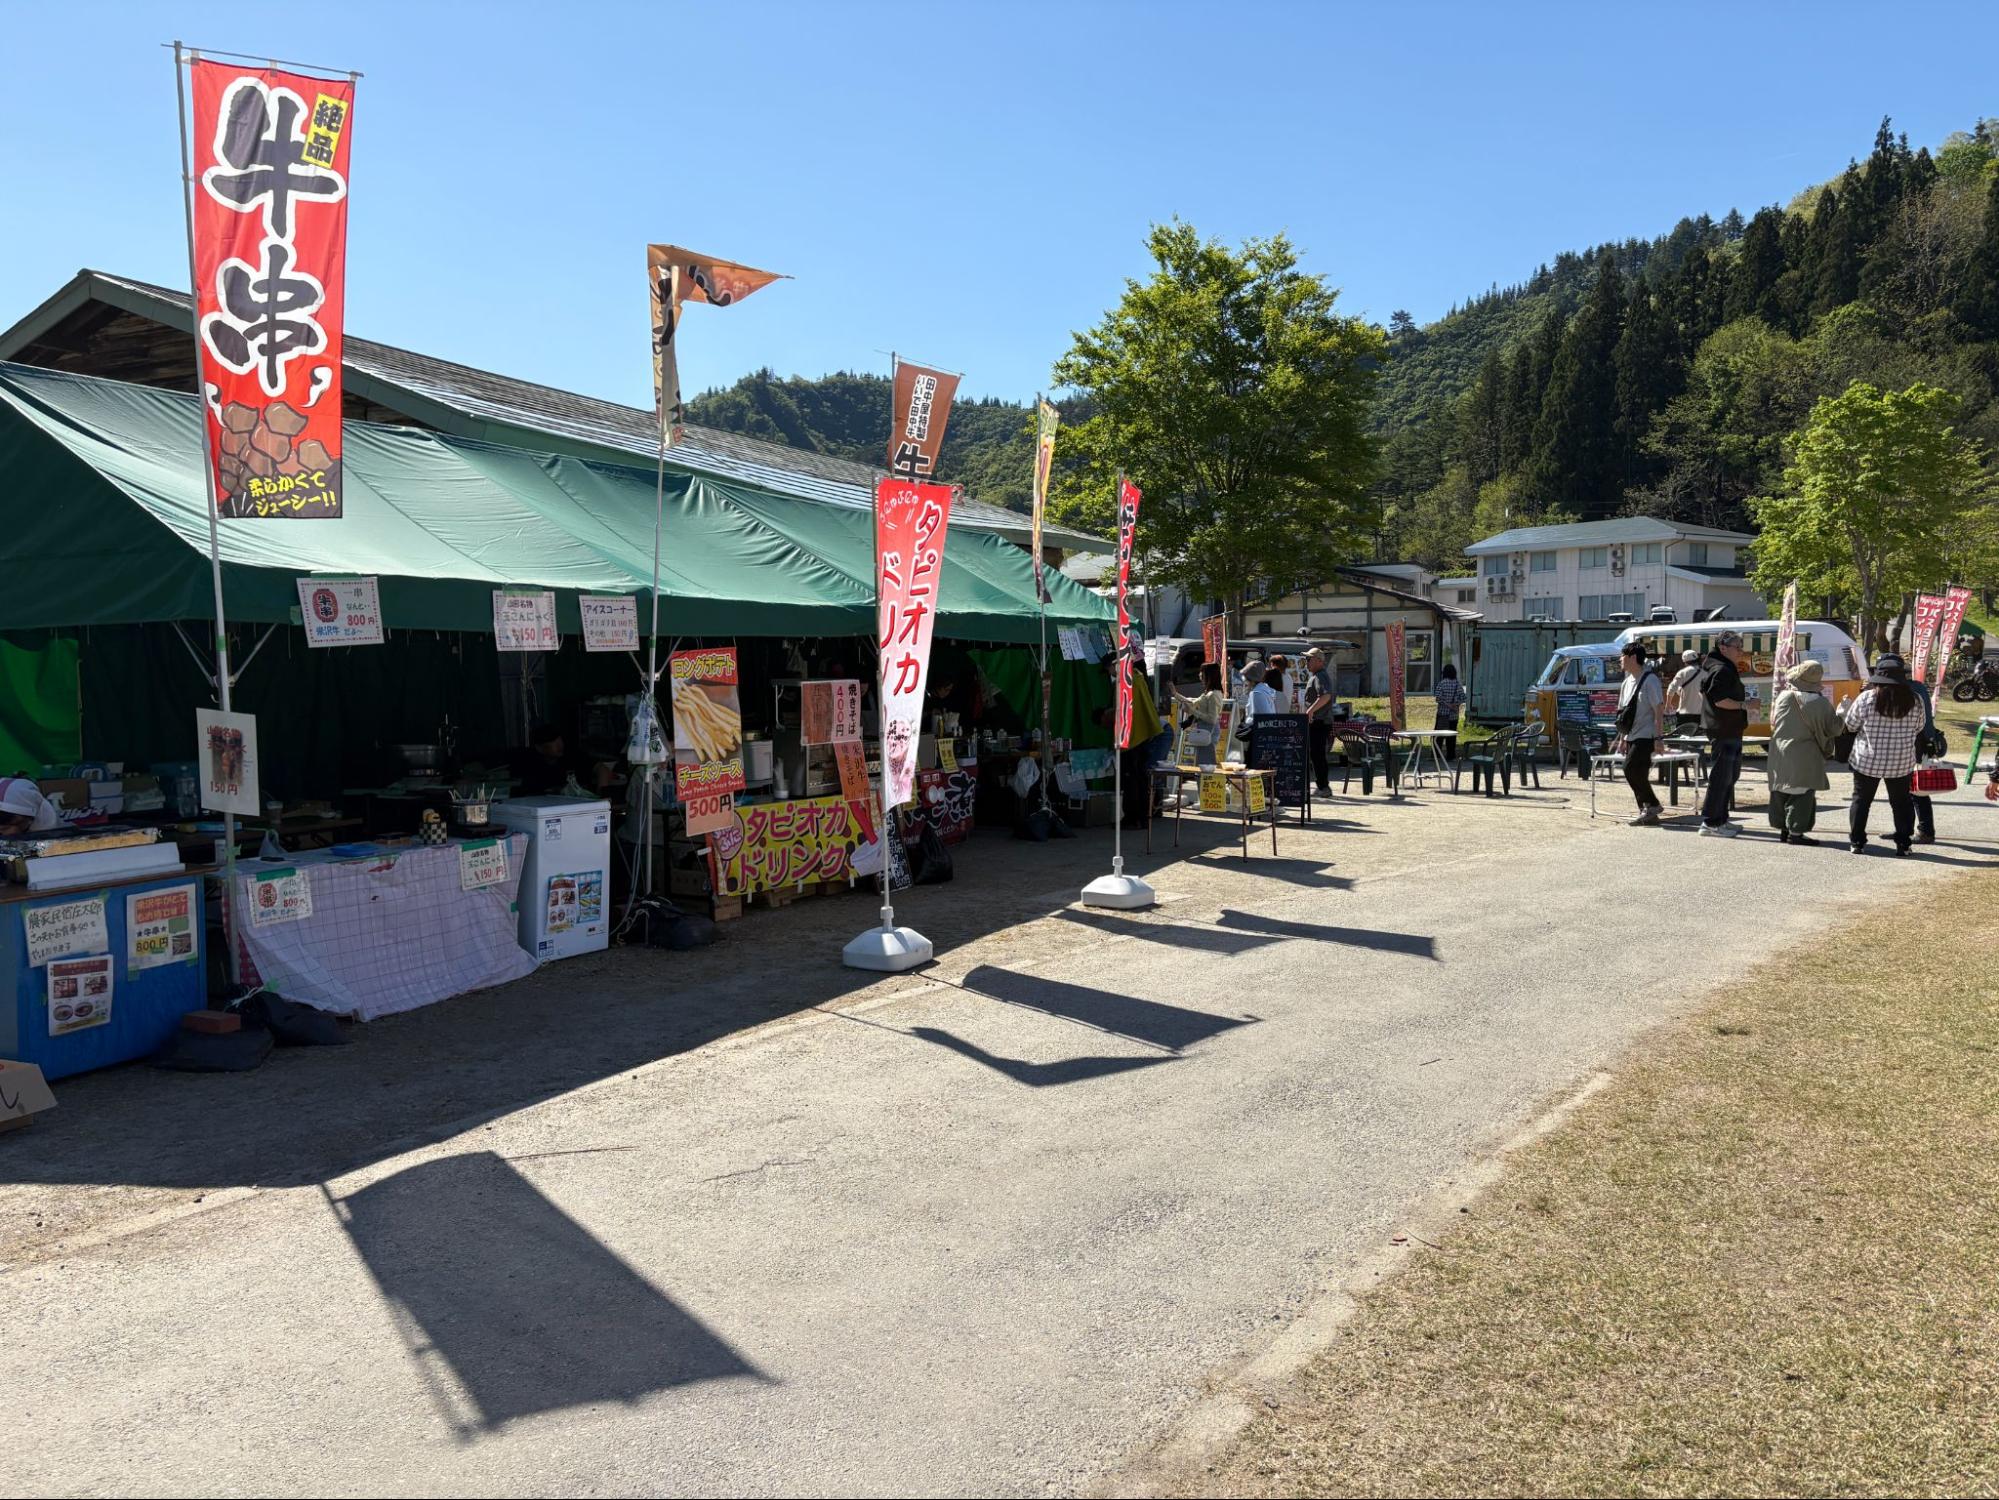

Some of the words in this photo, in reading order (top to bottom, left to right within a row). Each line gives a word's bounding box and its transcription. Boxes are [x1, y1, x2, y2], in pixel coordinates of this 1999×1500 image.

[305, 100, 342, 165] 絶品
[202, 76, 347, 397] 牛串
[917, 376, 937, 441] 田中屋特製
[248, 473, 326, 501] 柔らかくて
[255, 489, 338, 518] ジューシー!!
[584, 605, 634, 615] アイスコーナー
[892, 499, 942, 698] タピオカ
[346, 614, 375, 626] 800円
[672, 653, 736, 680] ロングポテト
[836, 685, 845, 737] 400円
[848, 683, 858, 735] 焼きそば
[210, 781, 238, 796] 150円
[678, 758, 743, 789] チーズソース
[689, 794, 732, 819] 500円
[746, 800, 848, 847] タピオカ
[739, 841, 847, 892] ドリンク
[135, 936, 169, 953] 800円
